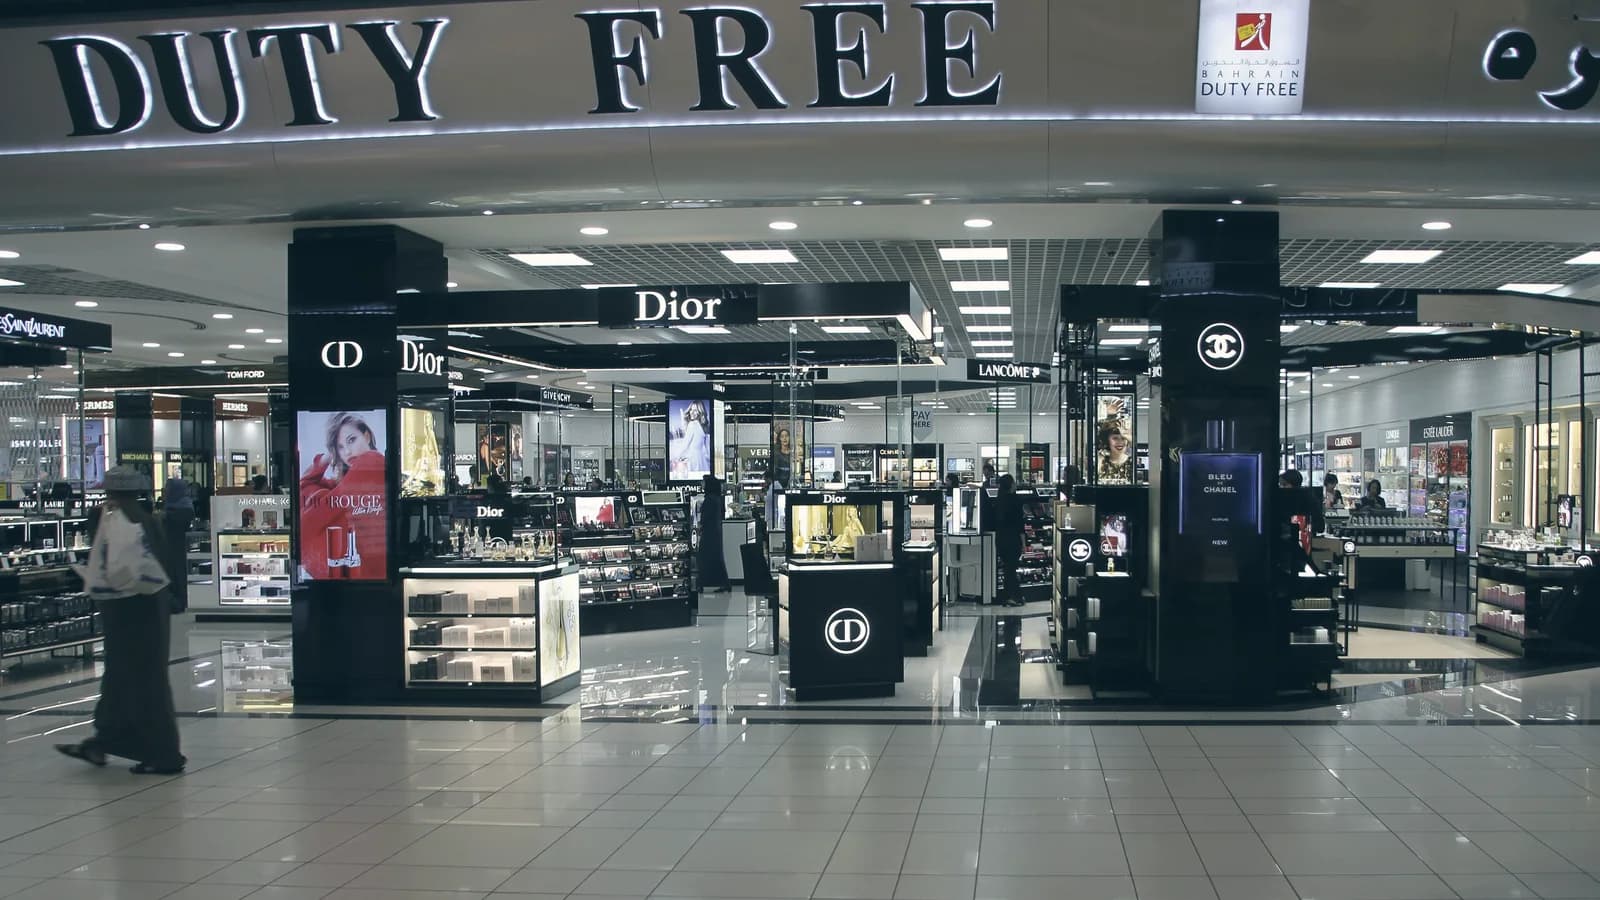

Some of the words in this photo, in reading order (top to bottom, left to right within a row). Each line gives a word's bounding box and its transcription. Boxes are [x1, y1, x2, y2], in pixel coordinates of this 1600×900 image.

[38, 19, 449, 136] DUTY
[574, 2, 1001, 114] FREE
[1202, 70, 1299, 78] BAHRAIN
[1201, 83, 1250, 96] DUTY
[1256, 83, 1297, 96] FREE
[634, 290, 721, 320] Dior
[401, 339, 444, 375] Dior
[226, 371, 243, 379] TOM
[244, 370, 265, 378] FORD
[979, 364, 1029, 378] LANCÔME
[543, 391, 570, 402] GIVENCHY
[913, 411, 930, 420] PAY
[1435, 425, 1454, 438] LAUDER
[331, 495, 381, 508] ROUGE
[823, 495, 847, 503] Dior
[477, 506, 504, 517] Dior
